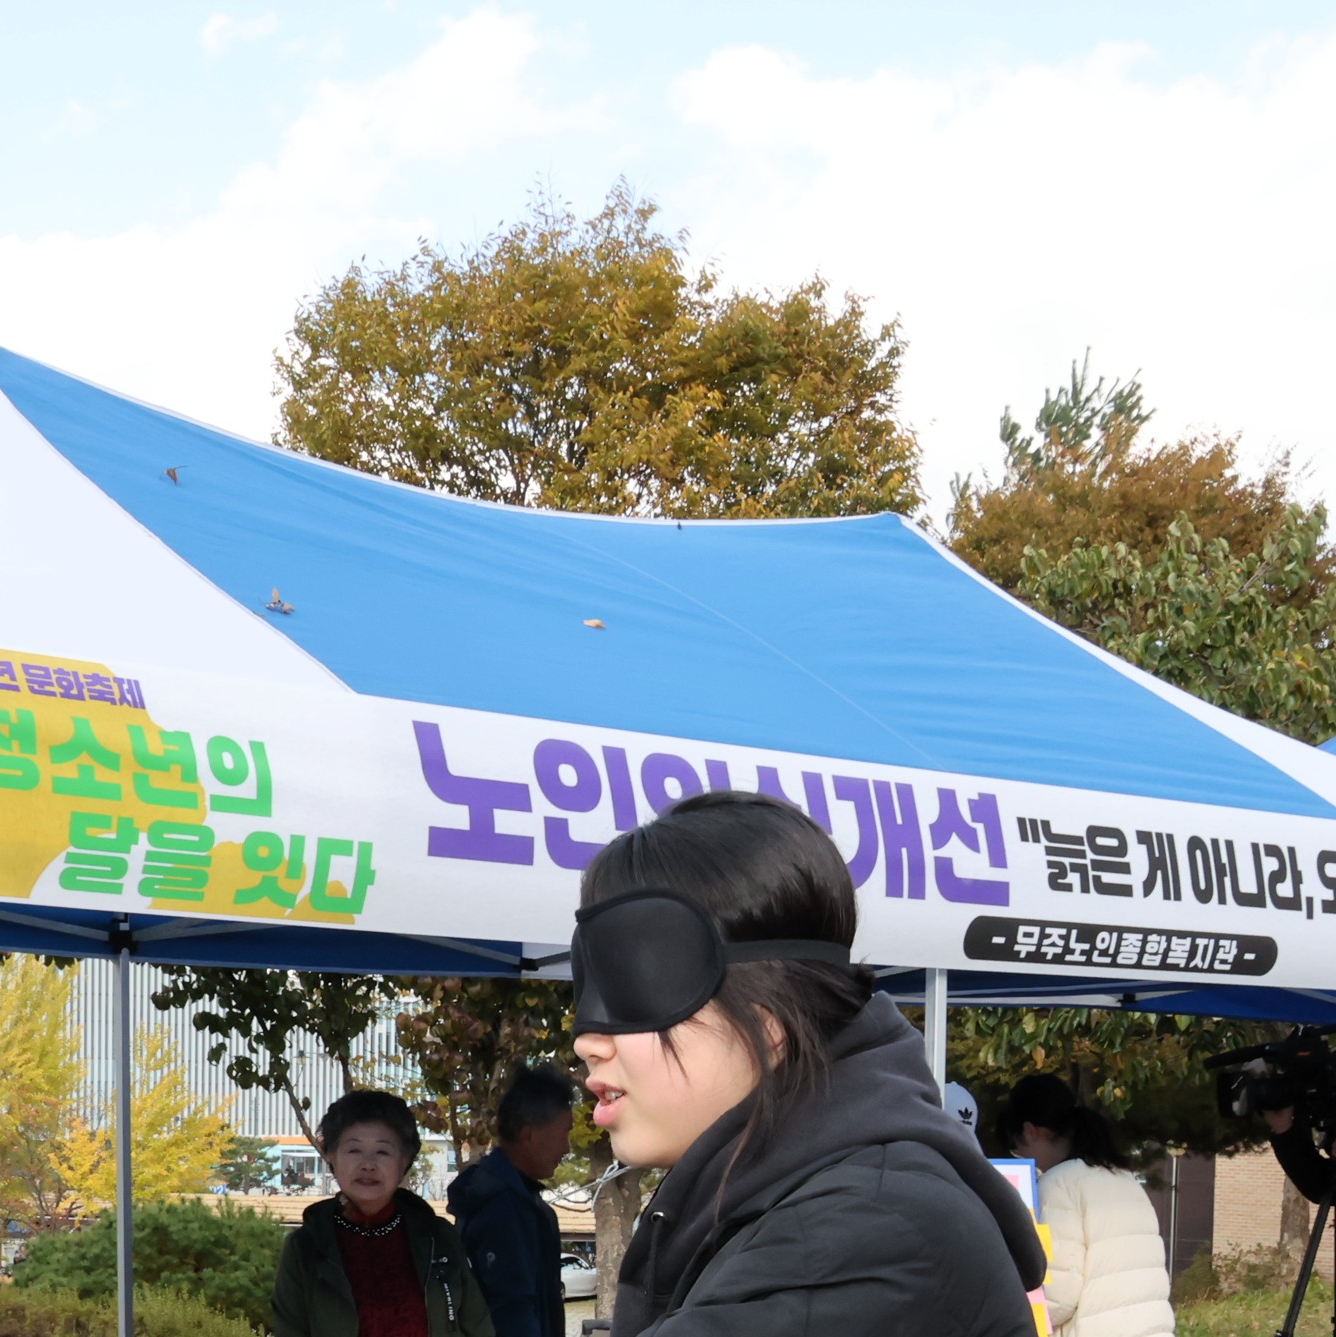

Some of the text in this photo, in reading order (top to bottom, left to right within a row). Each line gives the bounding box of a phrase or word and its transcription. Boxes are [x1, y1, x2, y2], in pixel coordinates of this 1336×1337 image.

[20, 663, 147, 710] 문화축제
[58, 810, 376, 915] 달을 잇다
[1016, 816, 1134, 898] "늙은
[1135, 829, 1183, 902] 게
[1186, 834, 1314, 920] 아니라,
[1013, 925, 1239, 970] 무주노인종합복지관
